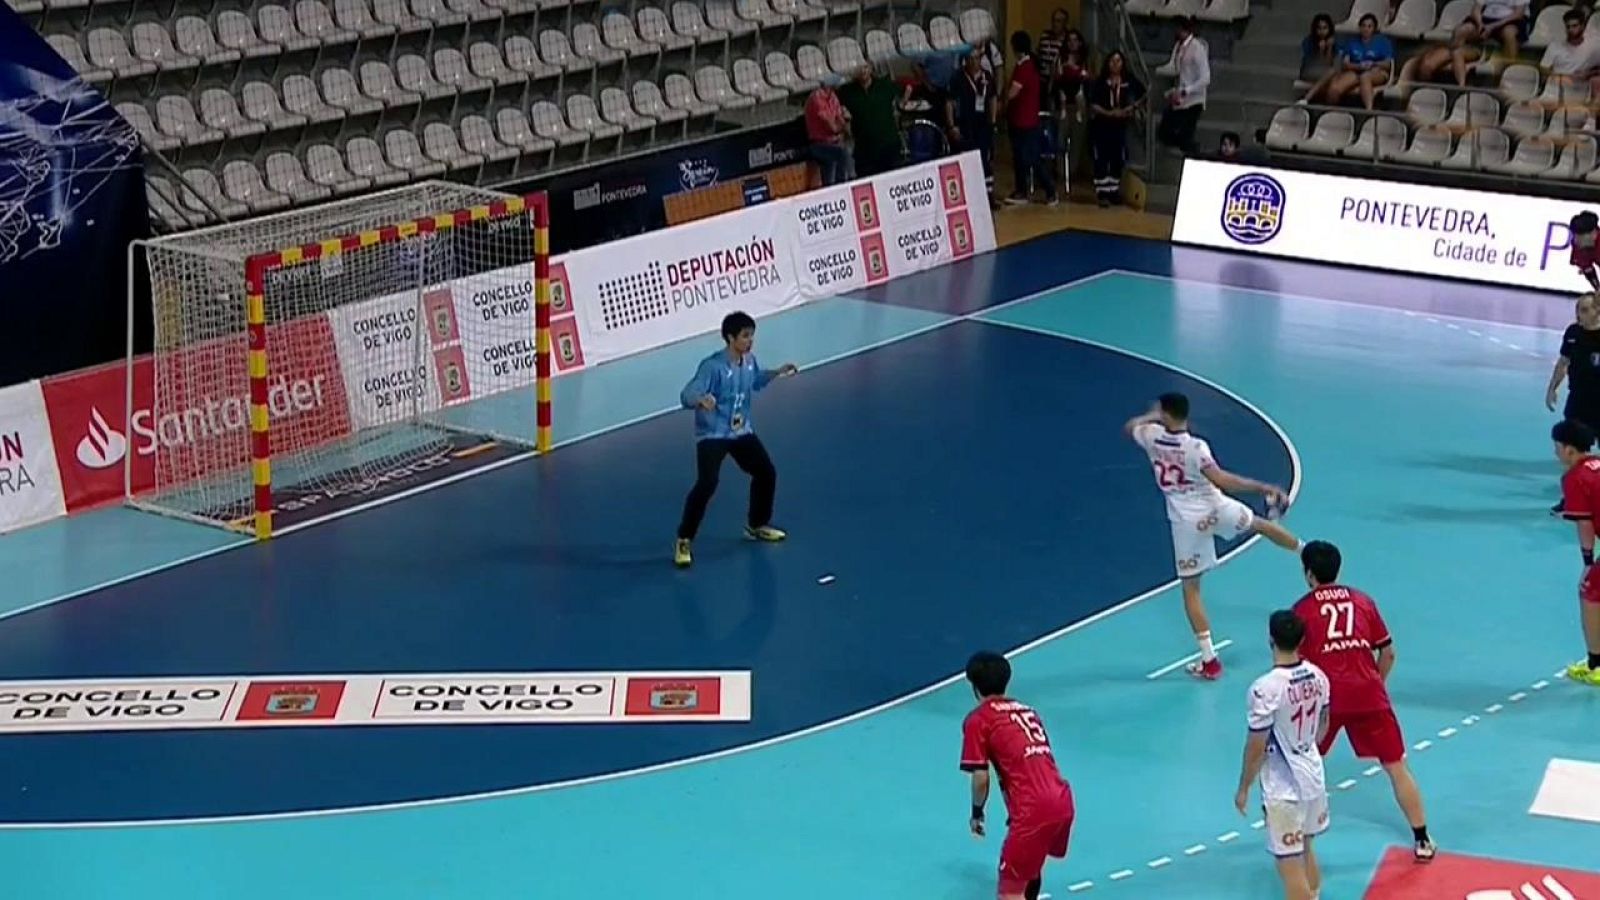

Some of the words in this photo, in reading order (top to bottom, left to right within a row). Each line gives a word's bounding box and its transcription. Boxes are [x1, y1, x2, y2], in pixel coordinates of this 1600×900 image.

[889, 177, 934, 199] CONCELLO
[799, 199, 847, 221] CONCELLO
[897, 199, 909, 212] DE
[911, 194, 932, 208] VIGO
[807, 222, 819, 235] DE
[822, 216, 844, 231] VIGO
[1340, 197, 1496, 239] PONTEVEDRA.
[898, 225, 941, 248] CONCELLO
[667, 235, 775, 287] DEPUTACIÓN
[809, 250, 856, 272] CONCELLO
[905, 248, 918, 261] DE
[920, 243, 939, 256] VIGO
[1433, 238, 1497, 264] Cidade
[1504, 247, 1528, 267] de
[817, 272, 829, 286] DE
[832, 266, 853, 281] VIGO
[473, 281, 532, 306] CONCELLO
[671, 264, 781, 313] PONTEVEDRA
[482, 306, 499, 321] DE
[501, 299, 529, 317] VIGO
[353, 308, 416, 335] CONCELLO
[364, 334, 381, 350] DE
[384, 328, 411, 344] VIGO
[483, 339, 535, 362] CONCELL
[493, 362, 509, 376] DE
[375, 393, 392, 408] DE
[1154, 460, 1194, 487] 22
[1315, 589, 1350, 601] OSUGI
[1320, 602, 1354, 639] 27
[1321, 638, 1370, 653] JAPAN
[0, 688, 221, 704] CONCELLO
[389, 684, 603, 697] CONCELLO
[13, 706, 70, 720] DE
[85, 704, 185, 716] VIGO
[413, 699, 466, 711] DE
[479, 698, 574, 711] VIGO
[1010, 711, 1046, 743] 15
[1291, 700, 1317, 741] 11
